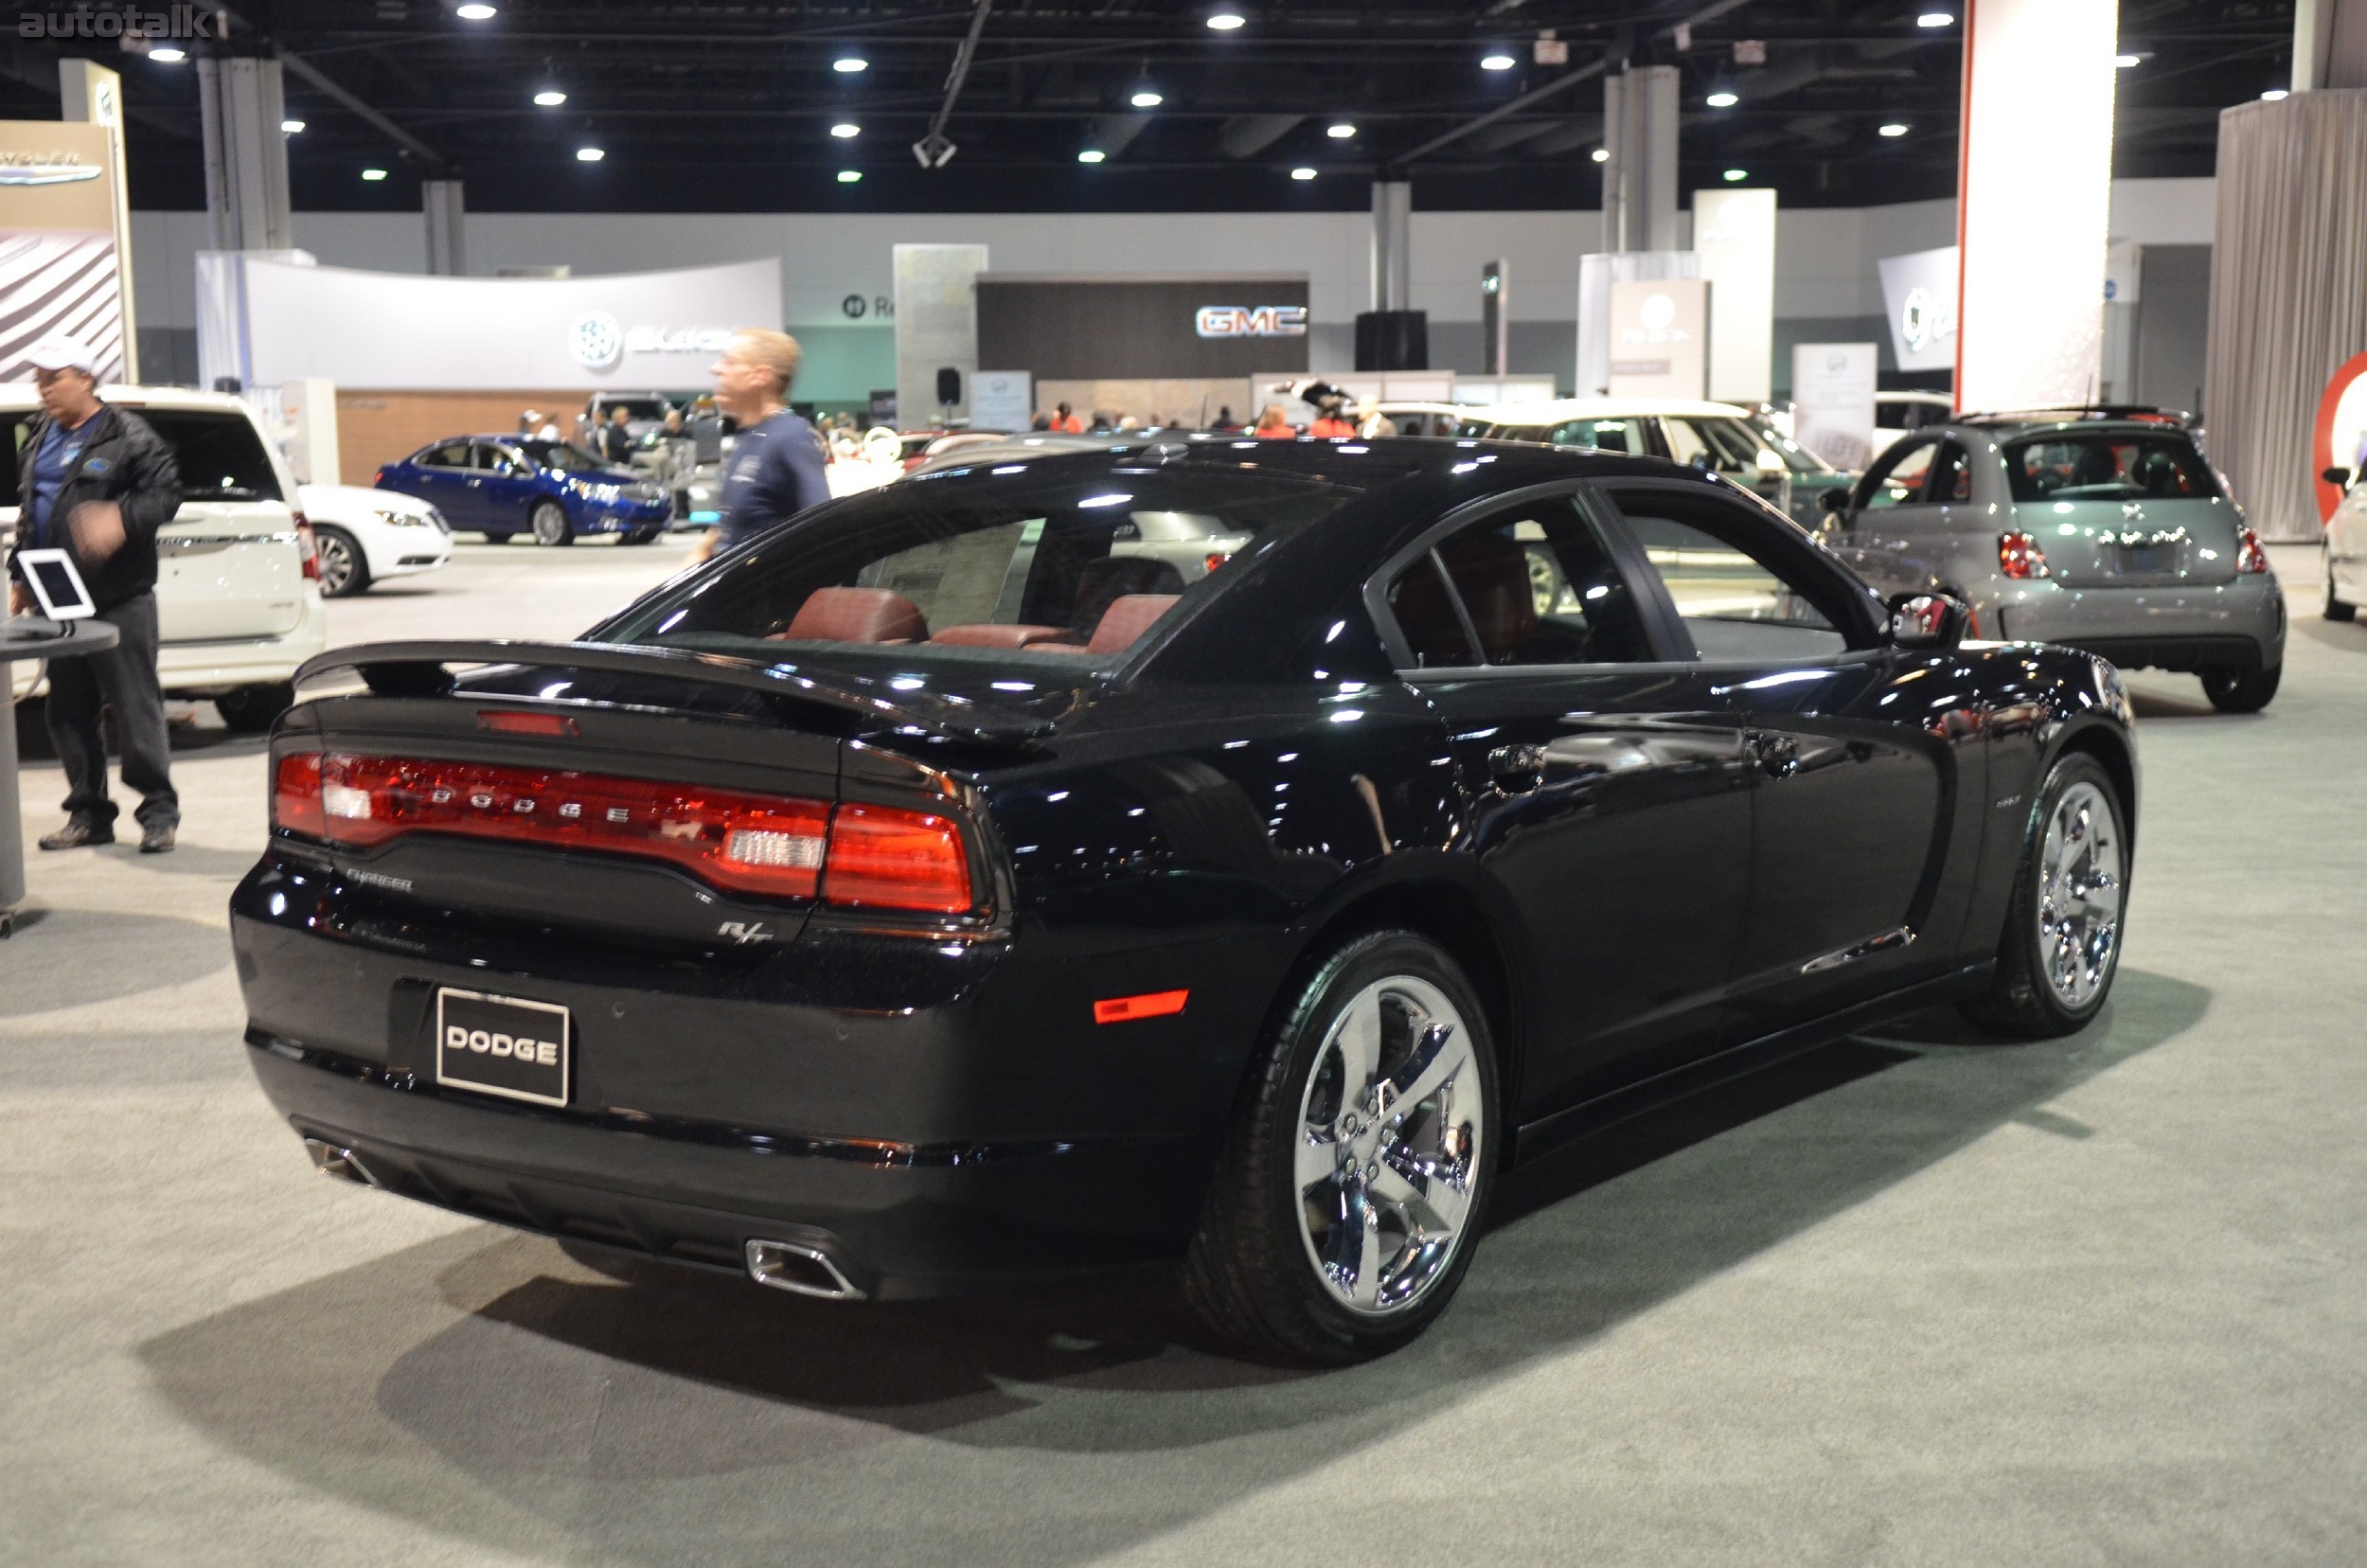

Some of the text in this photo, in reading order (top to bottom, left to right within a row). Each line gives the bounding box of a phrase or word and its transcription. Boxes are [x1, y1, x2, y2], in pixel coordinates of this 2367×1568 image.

[0, 151, 80, 167] YSLER
[1196, 306, 1307, 337] GMC
[432, 789, 629, 823] DODGE
[717, 921, 774, 946] R/T
[446, 1025, 558, 1066] DODGE
